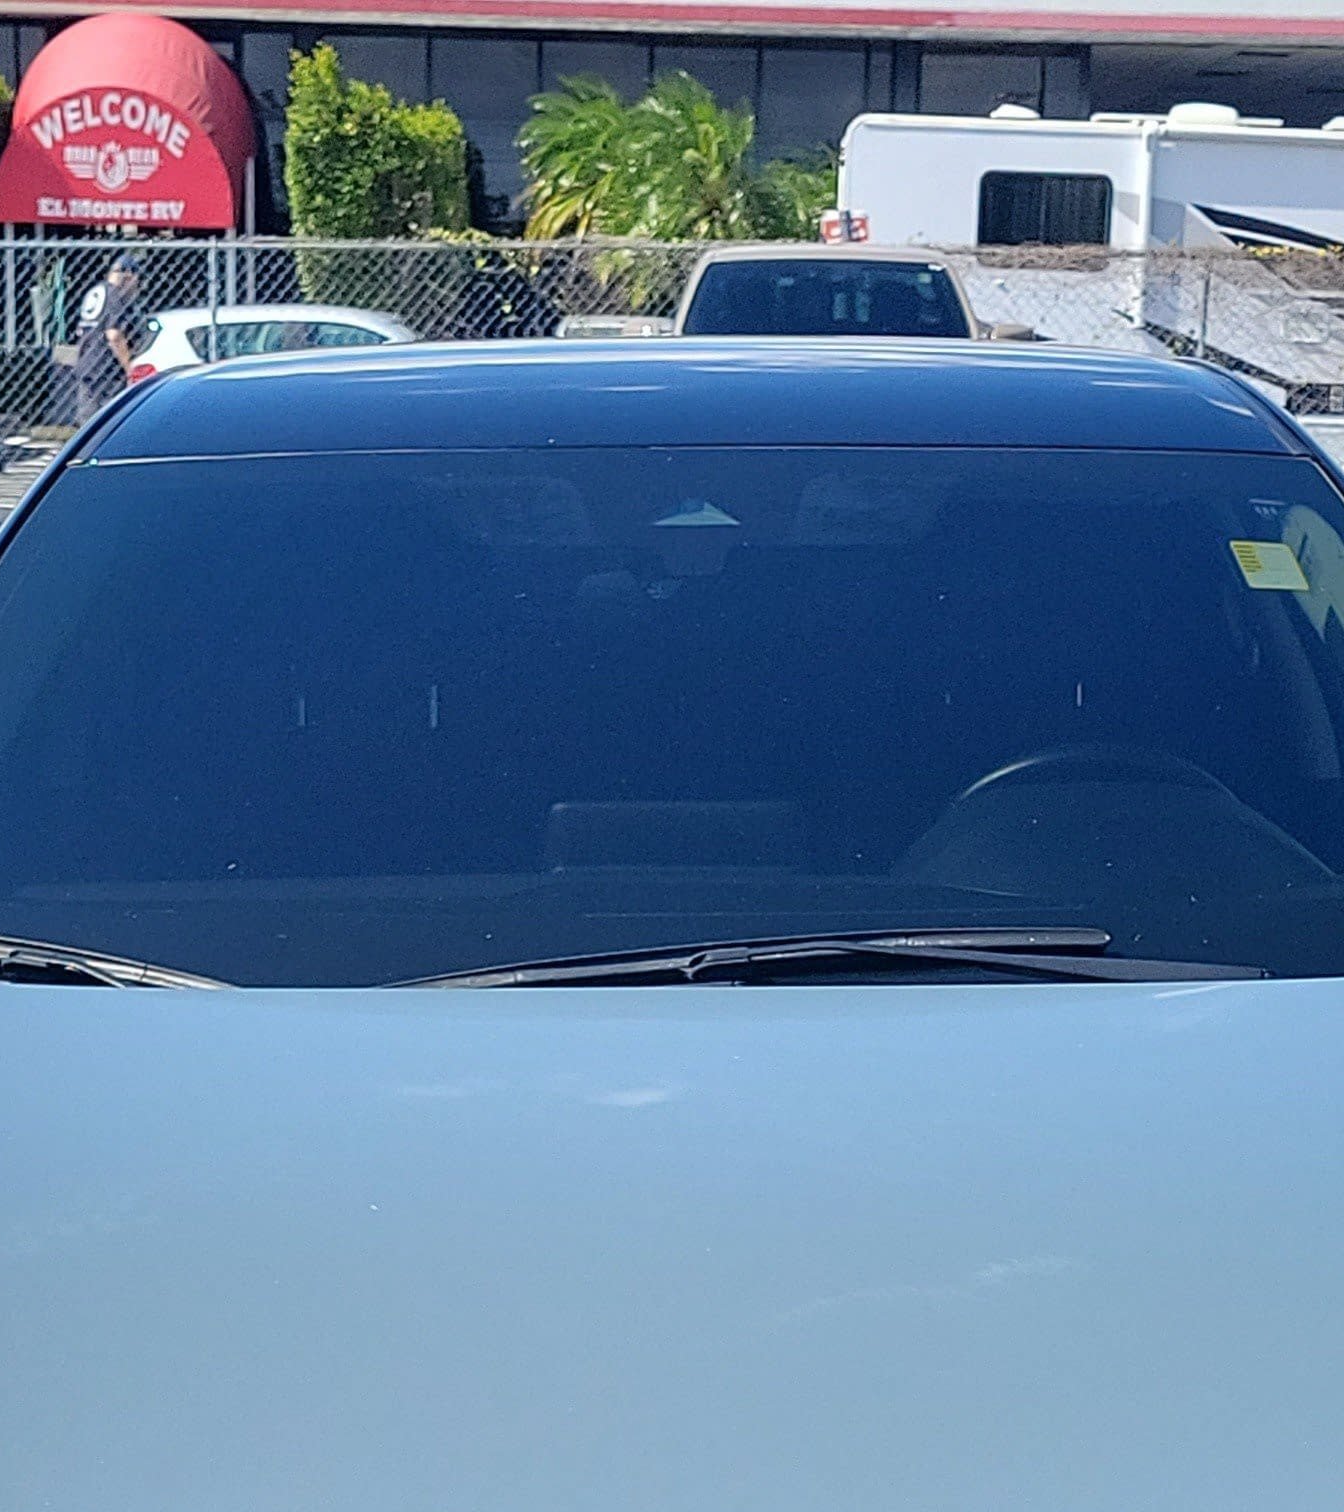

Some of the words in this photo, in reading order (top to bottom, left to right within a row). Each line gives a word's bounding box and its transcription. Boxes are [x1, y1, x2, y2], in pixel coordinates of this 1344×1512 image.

[31, 92, 191, 159] WELCOME
[37, 197, 67, 217] EL
[69, 199, 149, 220] MONTE
[150, 201, 185, 221] RV
